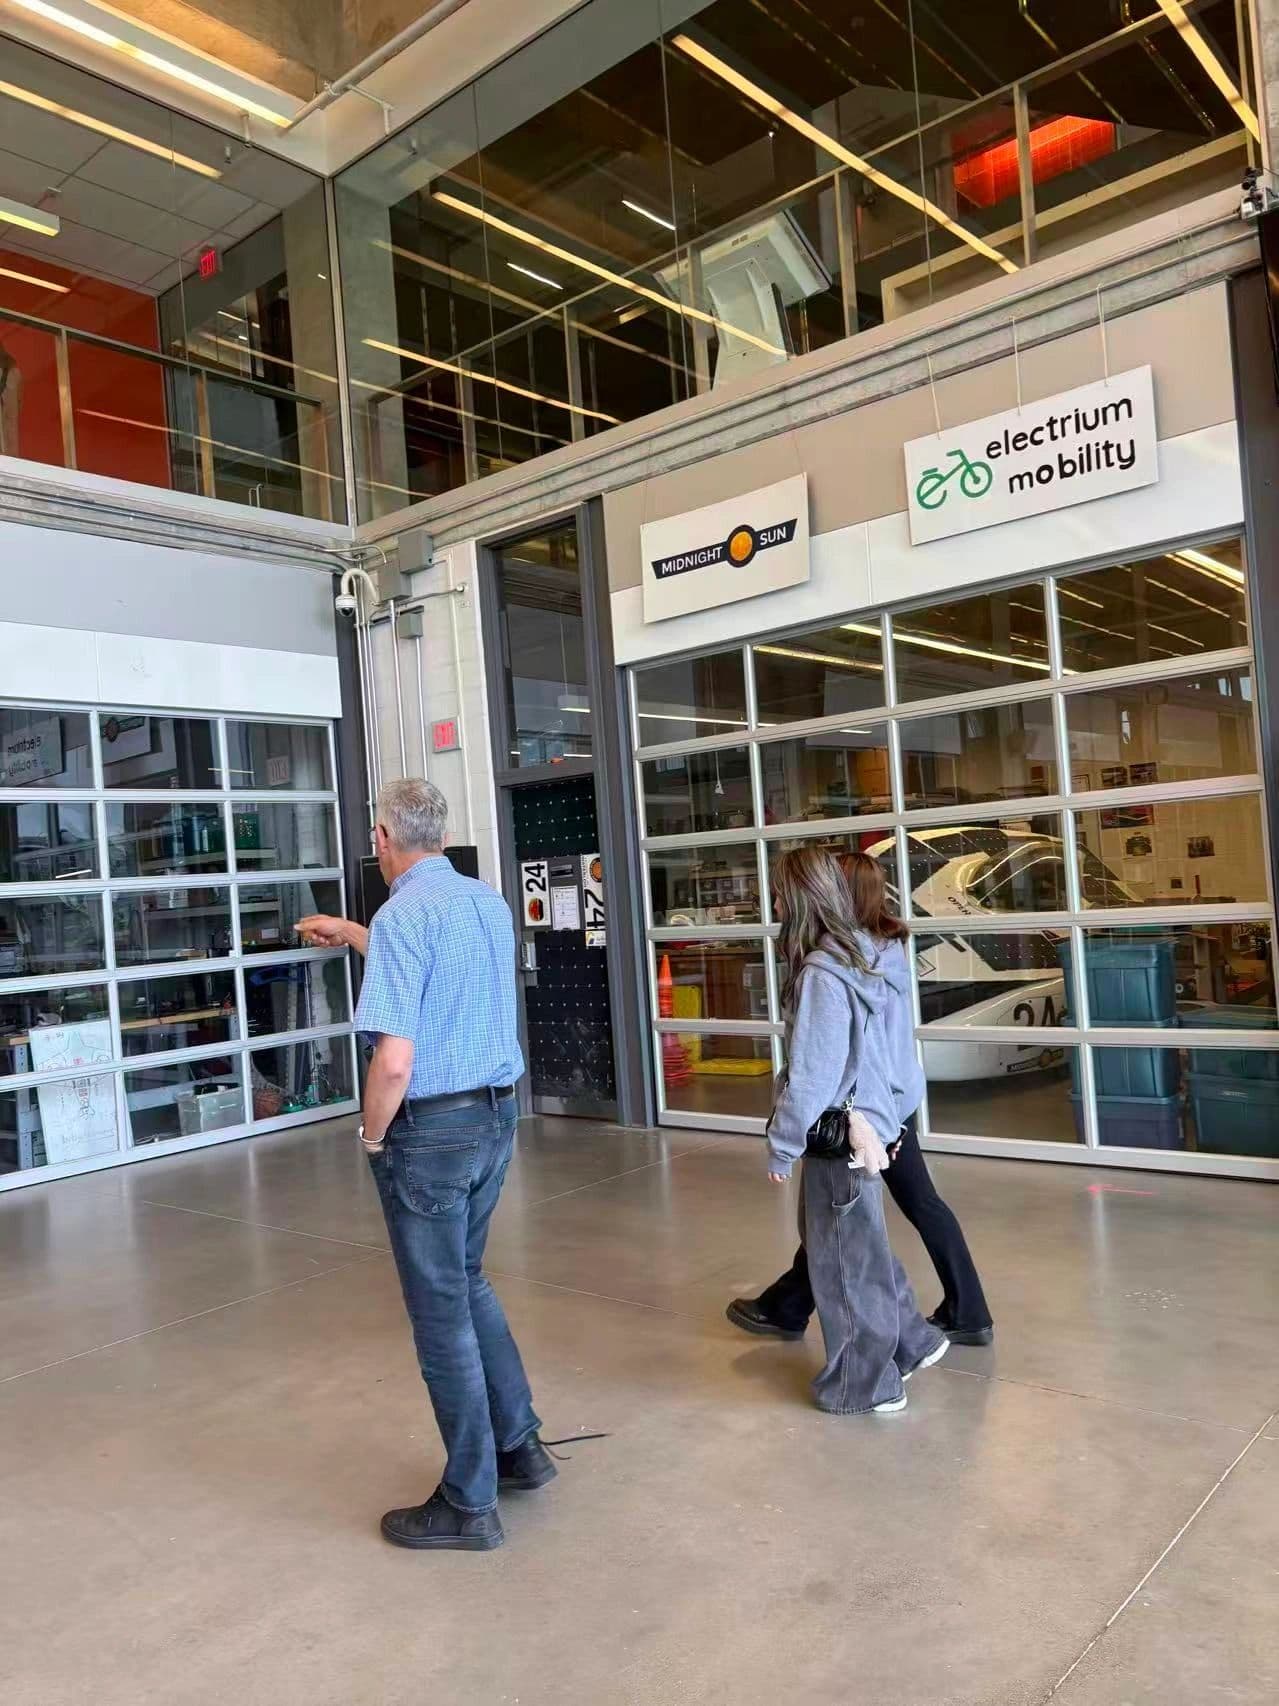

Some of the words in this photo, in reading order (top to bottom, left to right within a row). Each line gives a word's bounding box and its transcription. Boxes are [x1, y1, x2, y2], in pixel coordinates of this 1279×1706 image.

[986, 398, 1133, 459] electrium
[1009, 439, 1136, 493] mobility
[661, 547, 723, 574] MIDNIGHT
[759, 527, 788, 546] SUN
[524, 863, 546, 892] 24
[584, 888, 605, 928] 24
